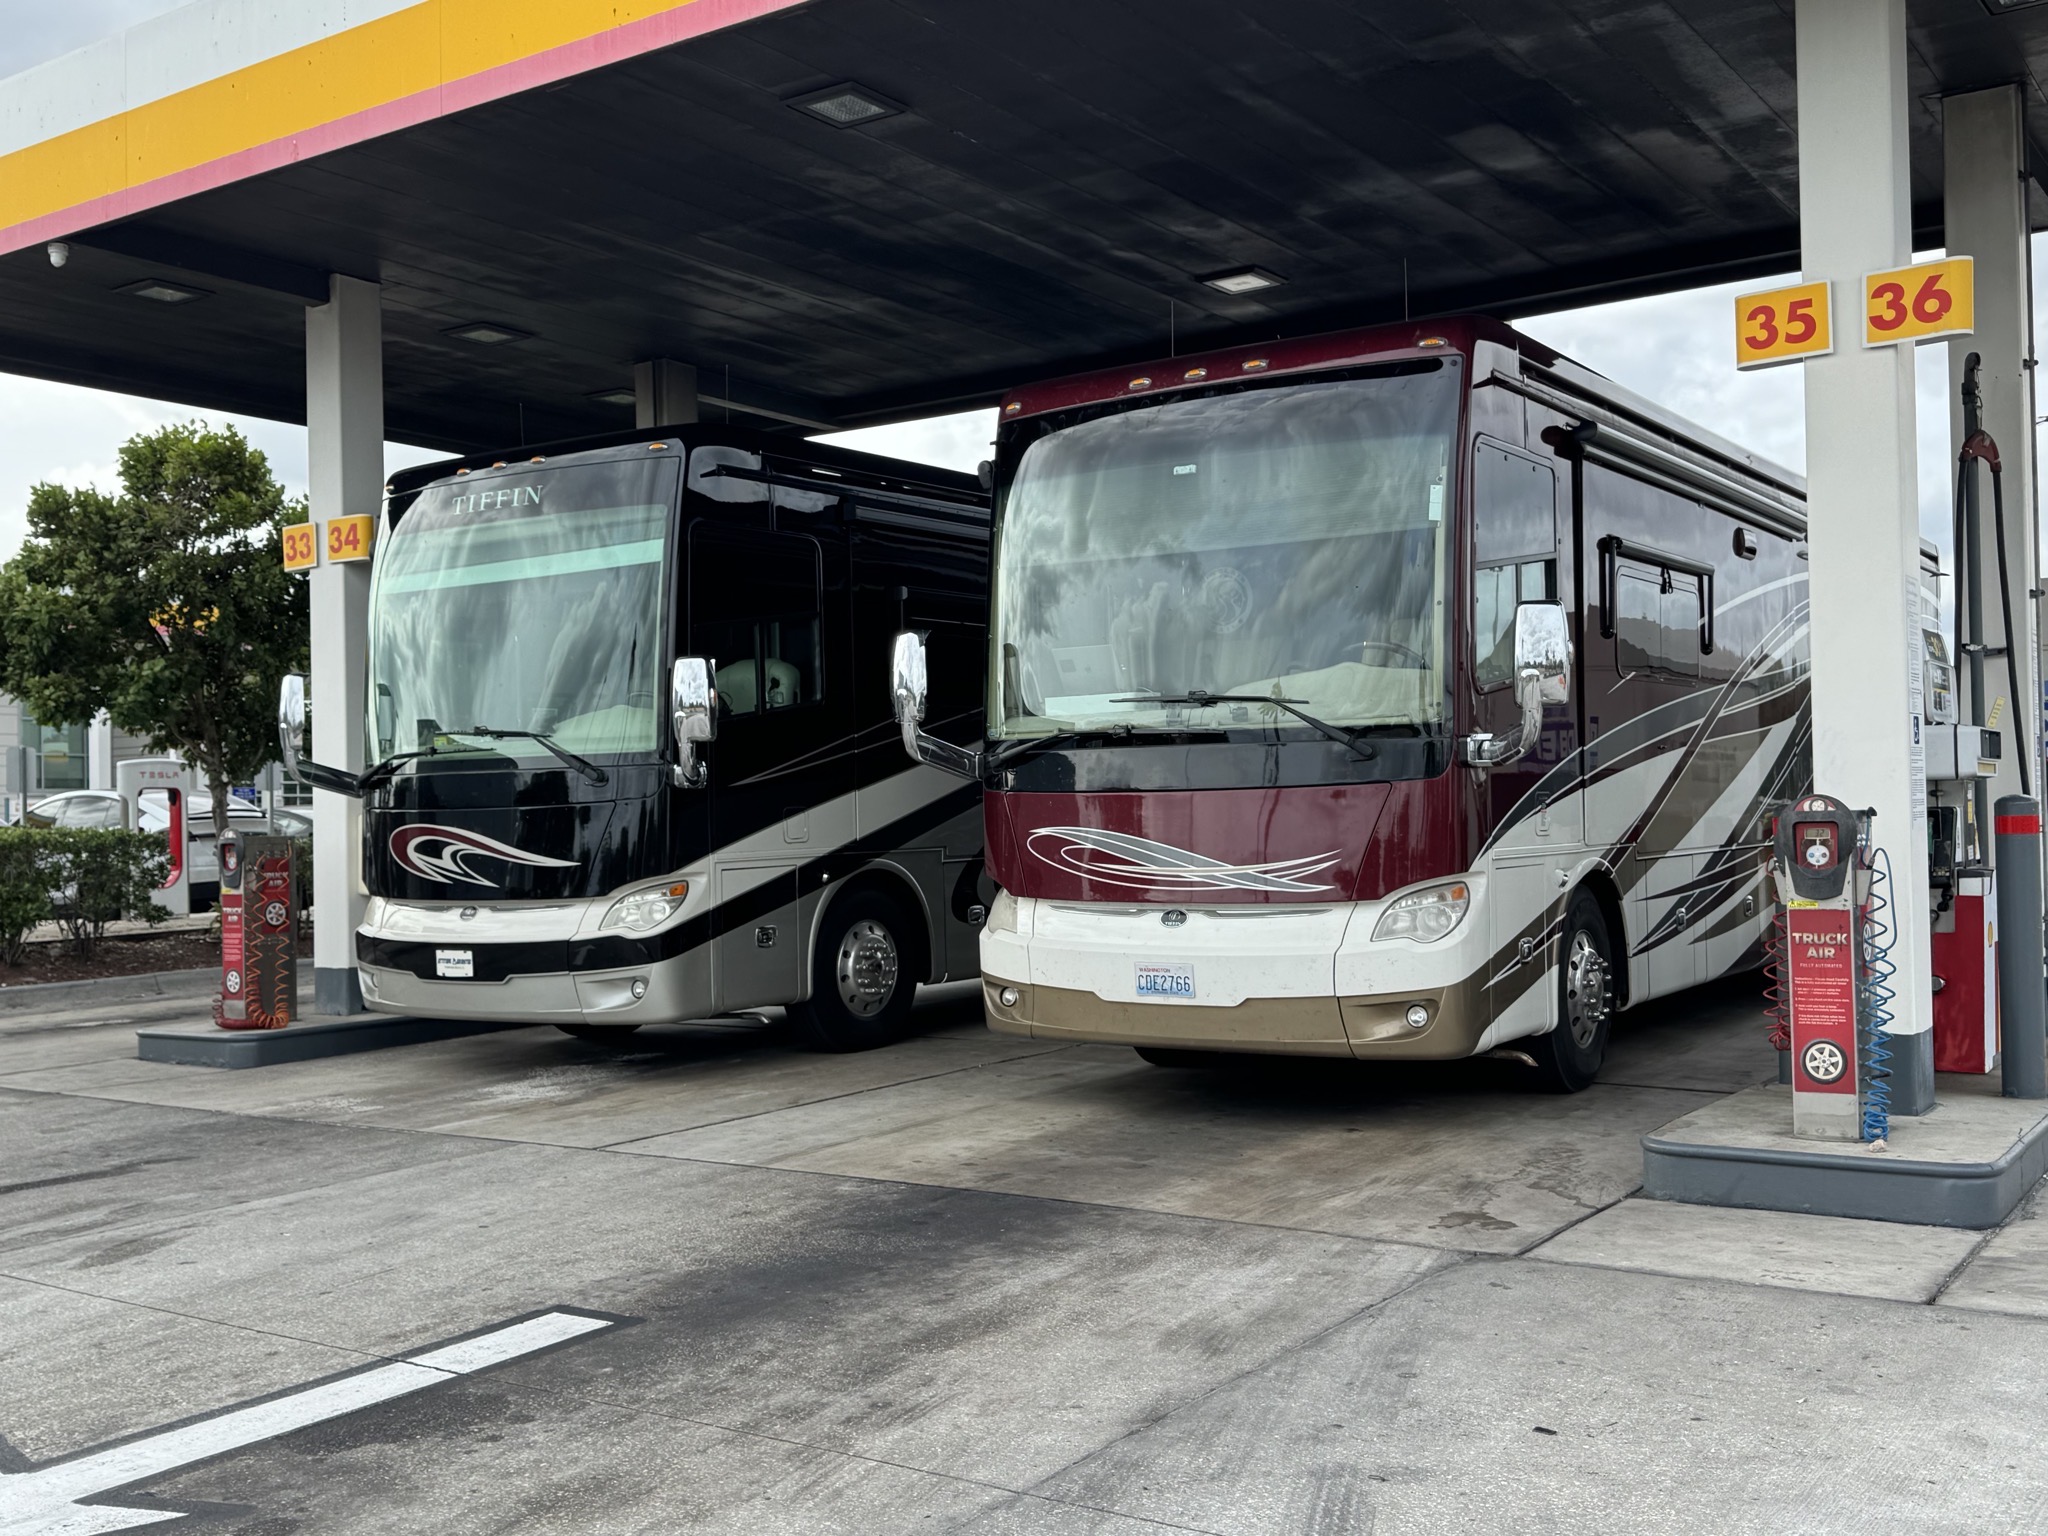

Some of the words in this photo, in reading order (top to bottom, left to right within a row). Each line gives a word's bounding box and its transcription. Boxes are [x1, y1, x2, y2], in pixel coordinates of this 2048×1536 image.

[1868, 273, 1953, 332] 36
[1744, 297, 1817, 351] 35
[451, 484, 544, 515] TIFFIN
[285, 531, 312, 562] 33
[329, 522, 360, 554] 34
[138, 771, 179, 779] TESLA
[1791, 932, 1848, 945] TRUCK
[1806, 946, 1836, 959] AIR
[1137, 974, 1191, 992] CDE2766
